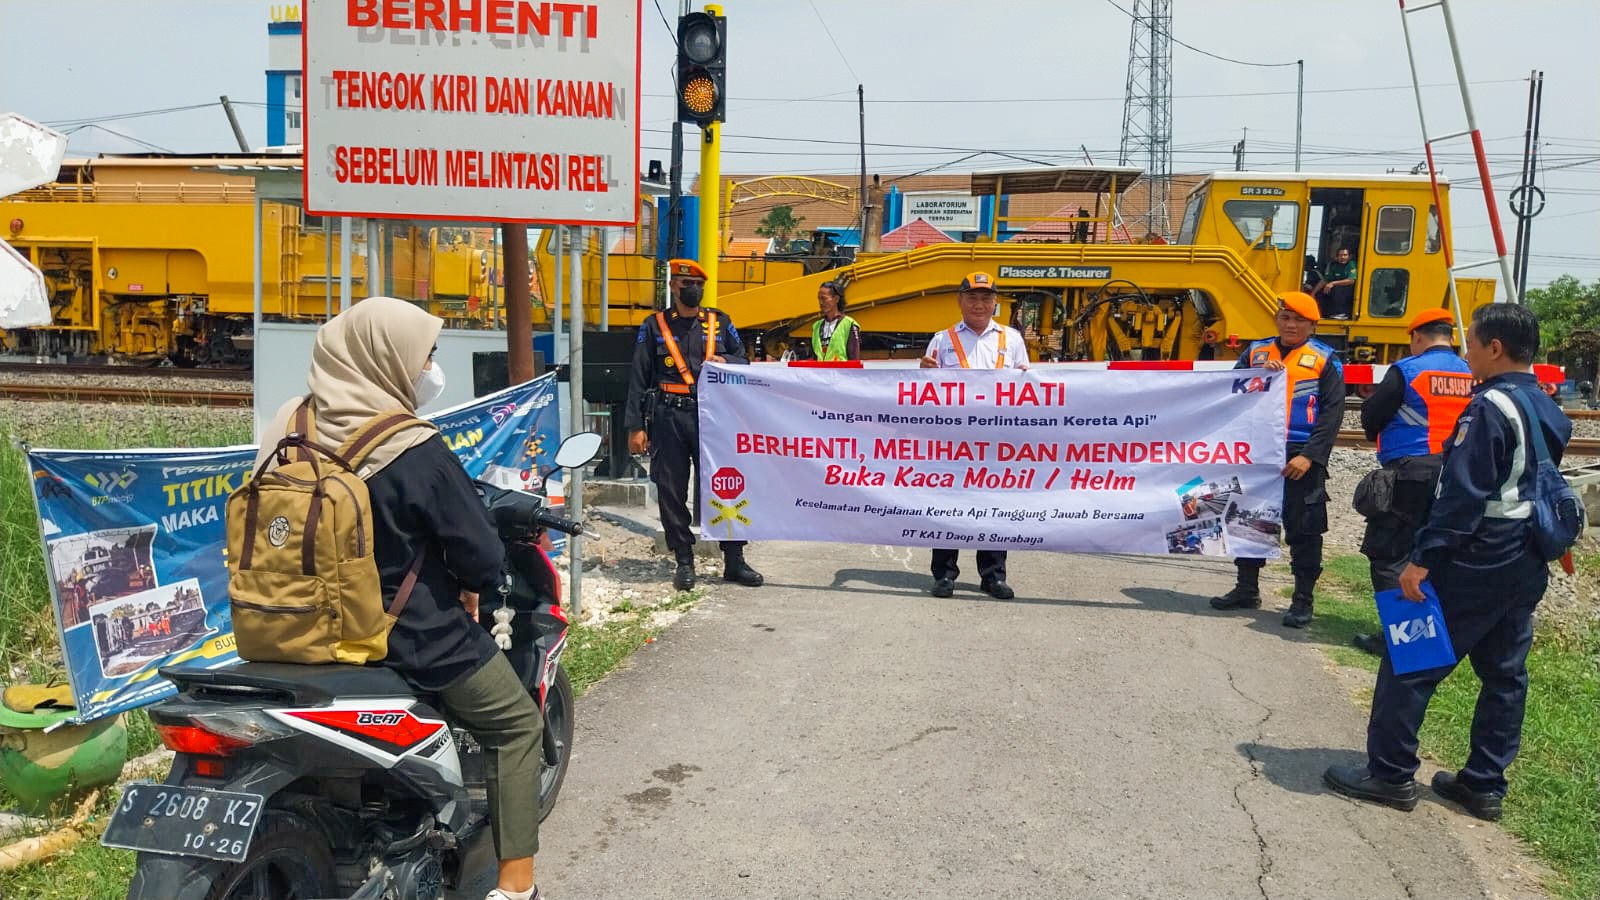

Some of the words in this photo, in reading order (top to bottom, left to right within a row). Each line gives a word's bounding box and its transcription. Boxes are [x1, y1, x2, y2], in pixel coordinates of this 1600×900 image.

[347, 0, 597, 39] BERHENTI
[332, 70, 425, 111] TENGOK
[433, 74, 477, 113] KIRI
[485, 76, 529, 115] DAN
[537, 78, 613, 119] KANAN
[335, 146, 438, 187] SEBELUM
[446, 149, 560, 191] MELINTASI
[568, 155, 609, 193] REL
[1000, 267, 1046, 277] Plasser
[1058, 267, 1109, 278] Theurer
[898, 382, 965, 406] HATI
[995, 382, 1065, 407] HATI
[1231, 376, 1273, 394] KAI
[1431, 376, 1477, 397] POLSUSK
[878, 413, 963, 426] Menerobos
[967, 415, 1058, 427] Perlintasan
[1063, 415, 1118, 427] Kereta
[736, 432, 865, 463] BERHENTI,
[873, 438, 990, 461] MELIHAT
[997, 442, 1057, 462] DAN
[1065, 441, 1253, 465] MENDENGAR
[162, 472, 235, 507] TITIK
[713, 476, 743, 491] STOP
[824, 464, 886, 487] Buka
[894, 465, 955, 488] Kaca
[963, 467, 1036, 489] Mobil
[1070, 468, 1136, 491] Helm
[161, 504, 219, 534] MAKA
[795, 498, 861, 513] Keselamatan
[863, 504, 923, 517] Perjalanan
[926, 506, 964, 518] Kereta
[967, 507, 988, 520] Api
[991, 507, 1047, 522] Tanggung
[1051, 508, 1089, 520] Jawab
[1092, 509, 1145, 521] Bersama
[901, 528, 917, 538] PT
[919, 529, 942, 540] KAI
[945, 531, 974, 543] Daop
[977, 532, 986, 542] 8
[989, 533, 1044, 545] Surabaya
[1388, 615, 1437, 646] KAI
[121, 789, 138, 813] S
[149, 791, 210, 821] 2608
[223, 799, 258, 827] KZ
